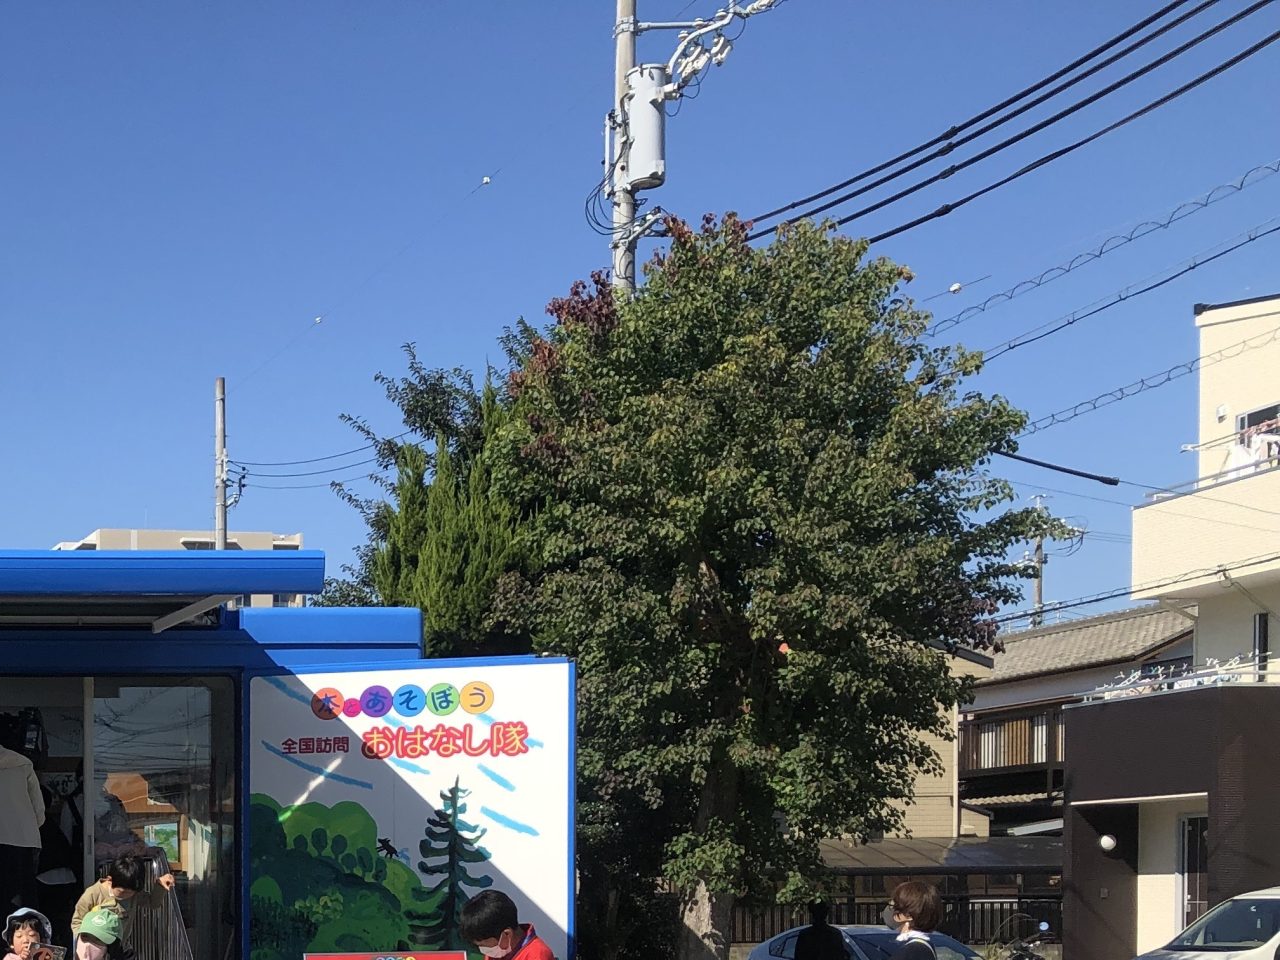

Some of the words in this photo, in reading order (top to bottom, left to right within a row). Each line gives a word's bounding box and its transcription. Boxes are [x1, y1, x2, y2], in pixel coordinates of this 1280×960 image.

[314, 684, 488, 715] 本とあそぼう
[281, 736, 350, 754] 全国訪問
[361, 721, 528, 760] おはなし隊
